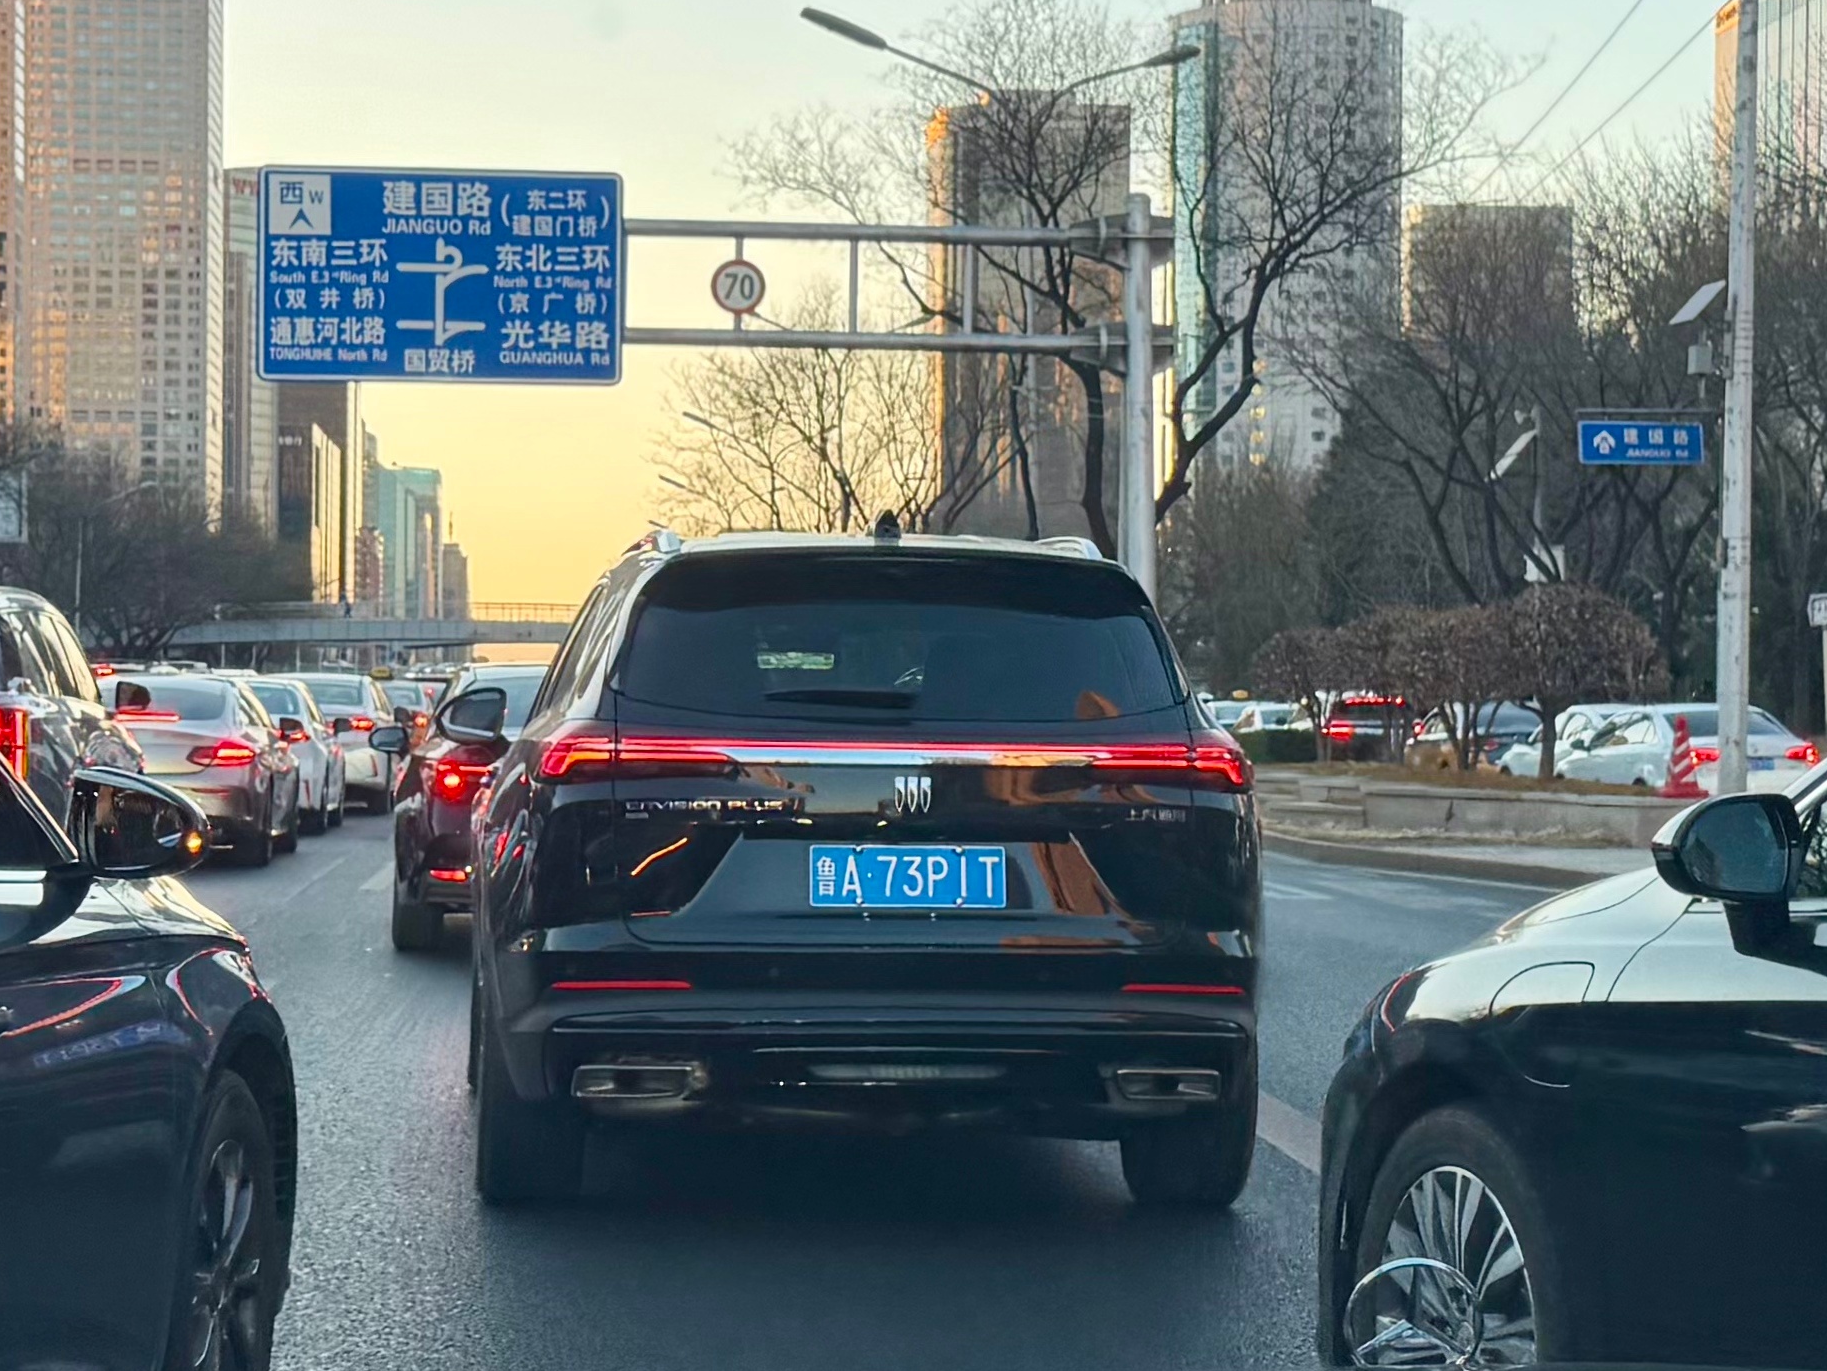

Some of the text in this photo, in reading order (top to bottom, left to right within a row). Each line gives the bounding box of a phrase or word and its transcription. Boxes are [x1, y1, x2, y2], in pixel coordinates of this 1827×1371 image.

[279, 181, 304, 204] 西
[309, 190, 324, 204] W
[383, 181, 492, 217] 建国路
[527, 189, 587, 211] 东二环
[382, 218, 491, 236] JIANGUO Rd
[512, 214, 598, 238] 建国门桥
[270, 238, 388, 268] 东南三环
[495, 243, 610, 273] 东北三环
[269, 271, 305, 284] South
[373, 271, 389, 284] Rd
[493, 275, 528, 289] North
[596, 276, 612, 289] Rd
[724, 272, 755, 301] 70
[270, 316, 386, 345] 通惠河北路
[501, 319, 610, 350] 光华路
[338, 348, 368, 362] North
[373, 348, 388, 362] Rd
[404, 348, 475, 373] 国贸桥
[499, 351, 610, 366] GUANGHUA Rd
[727, 800, 784, 812] PLUS
